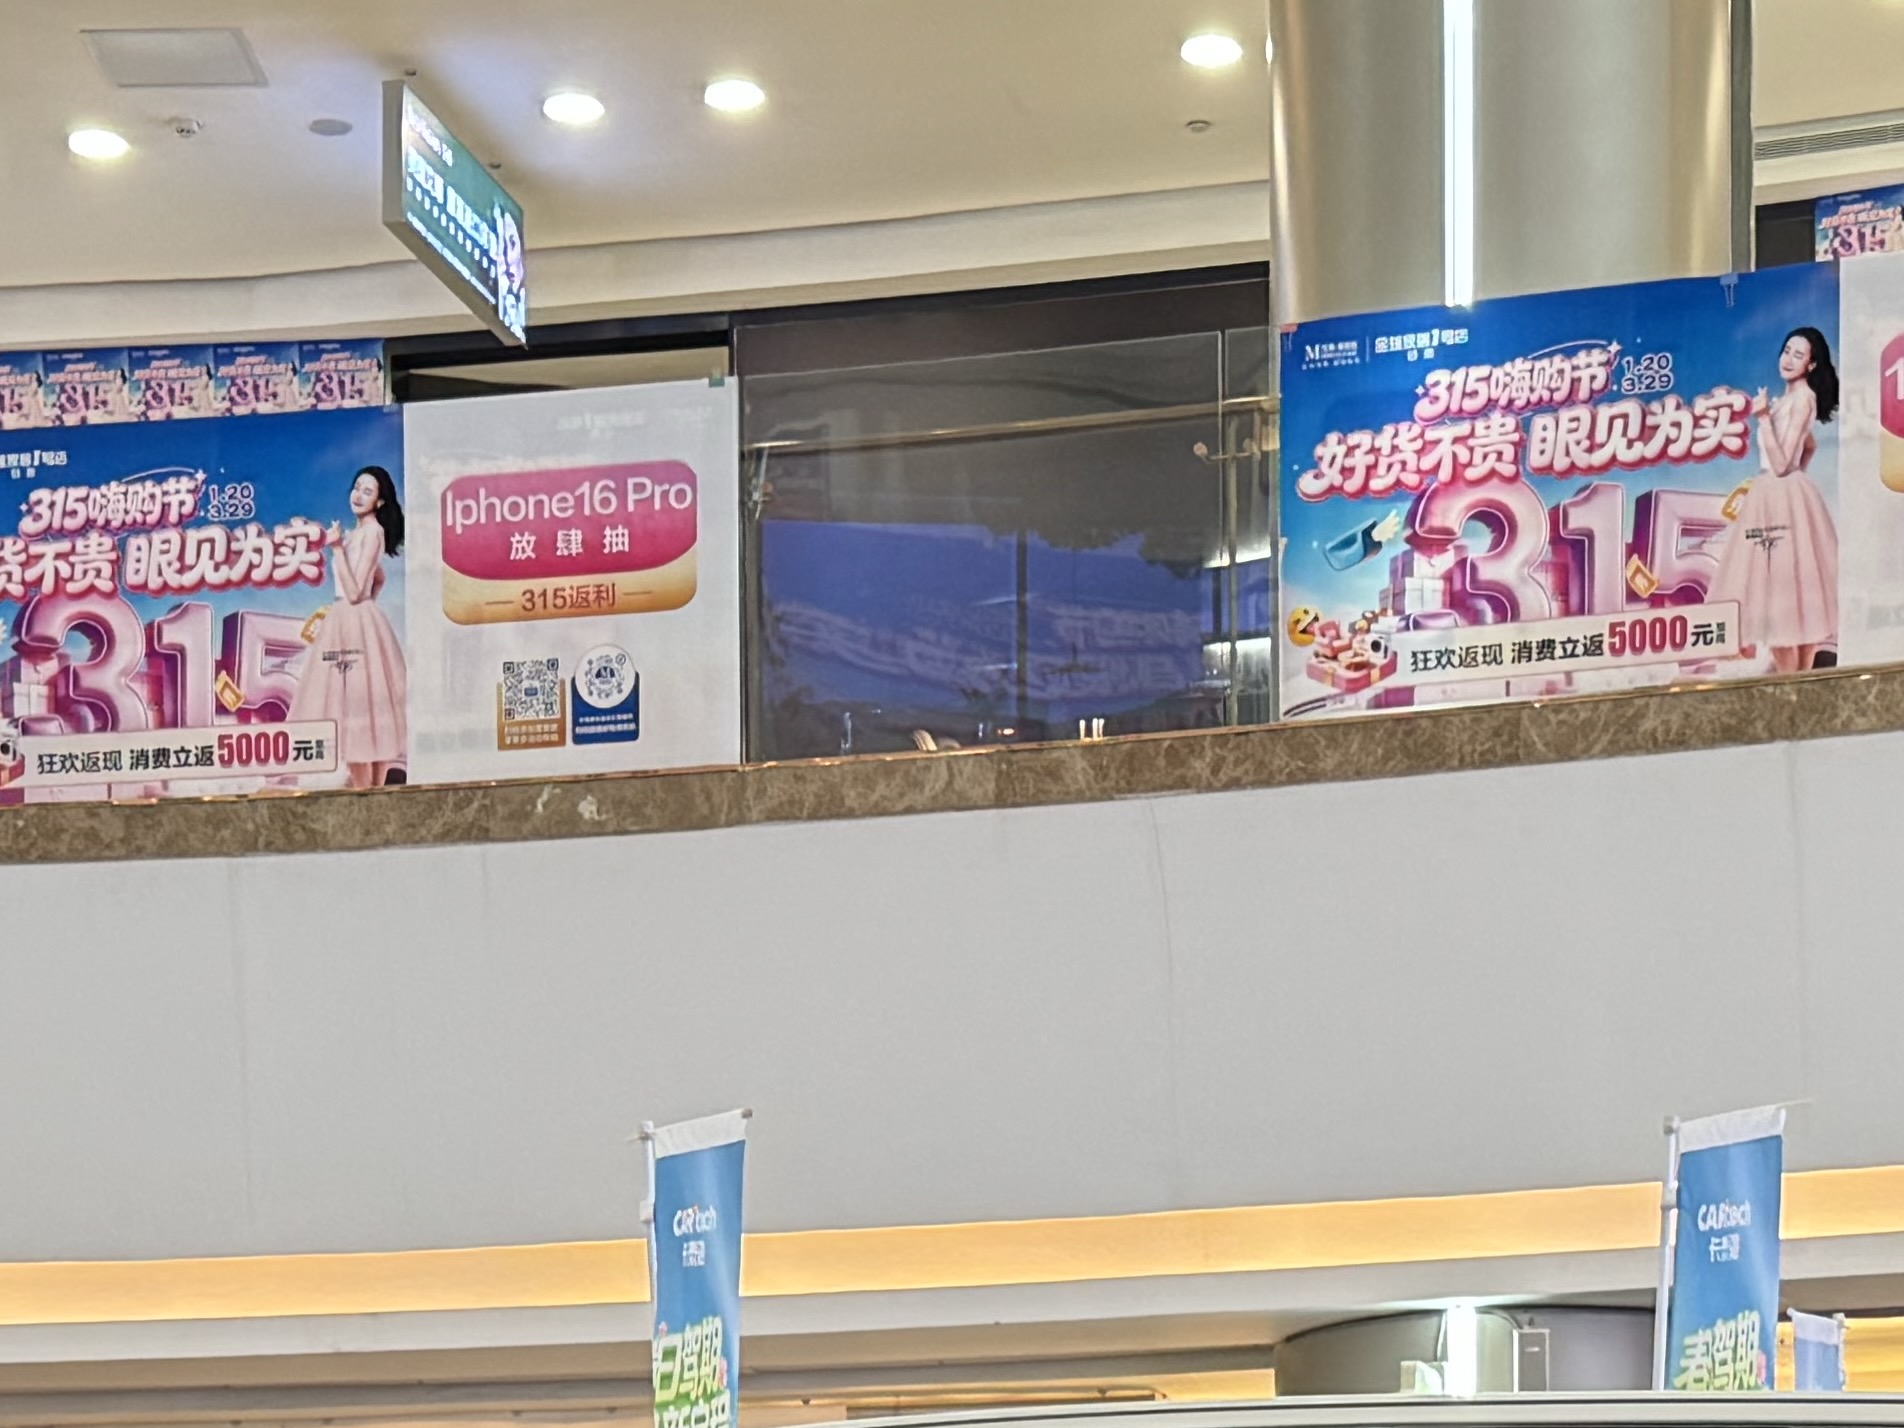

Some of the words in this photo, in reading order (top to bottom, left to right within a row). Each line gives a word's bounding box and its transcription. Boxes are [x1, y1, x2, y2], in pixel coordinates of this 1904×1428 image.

[1415, 349, 1612, 423] 315嗨购节
[1622, 374, 1673, 394] 3.29
[1296, 421, 1519, 501] 好货不贵
[1529, 388, 1752, 474] 眼见为实
[21, 478, 201, 538] 315嗨购节
[208, 501, 254, 519] 3.29
[446, 479, 617, 534] Iphone16
[627, 477, 693, 511] Pro
[125, 519, 324, 590] 眼见为实
[509, 525, 630, 560] 放肆抽
[521, 582, 617, 612] 315返利
[1411, 645, 1503, 672] 狂欢返现
[37, 752, 123, 774] 狂欢返现
